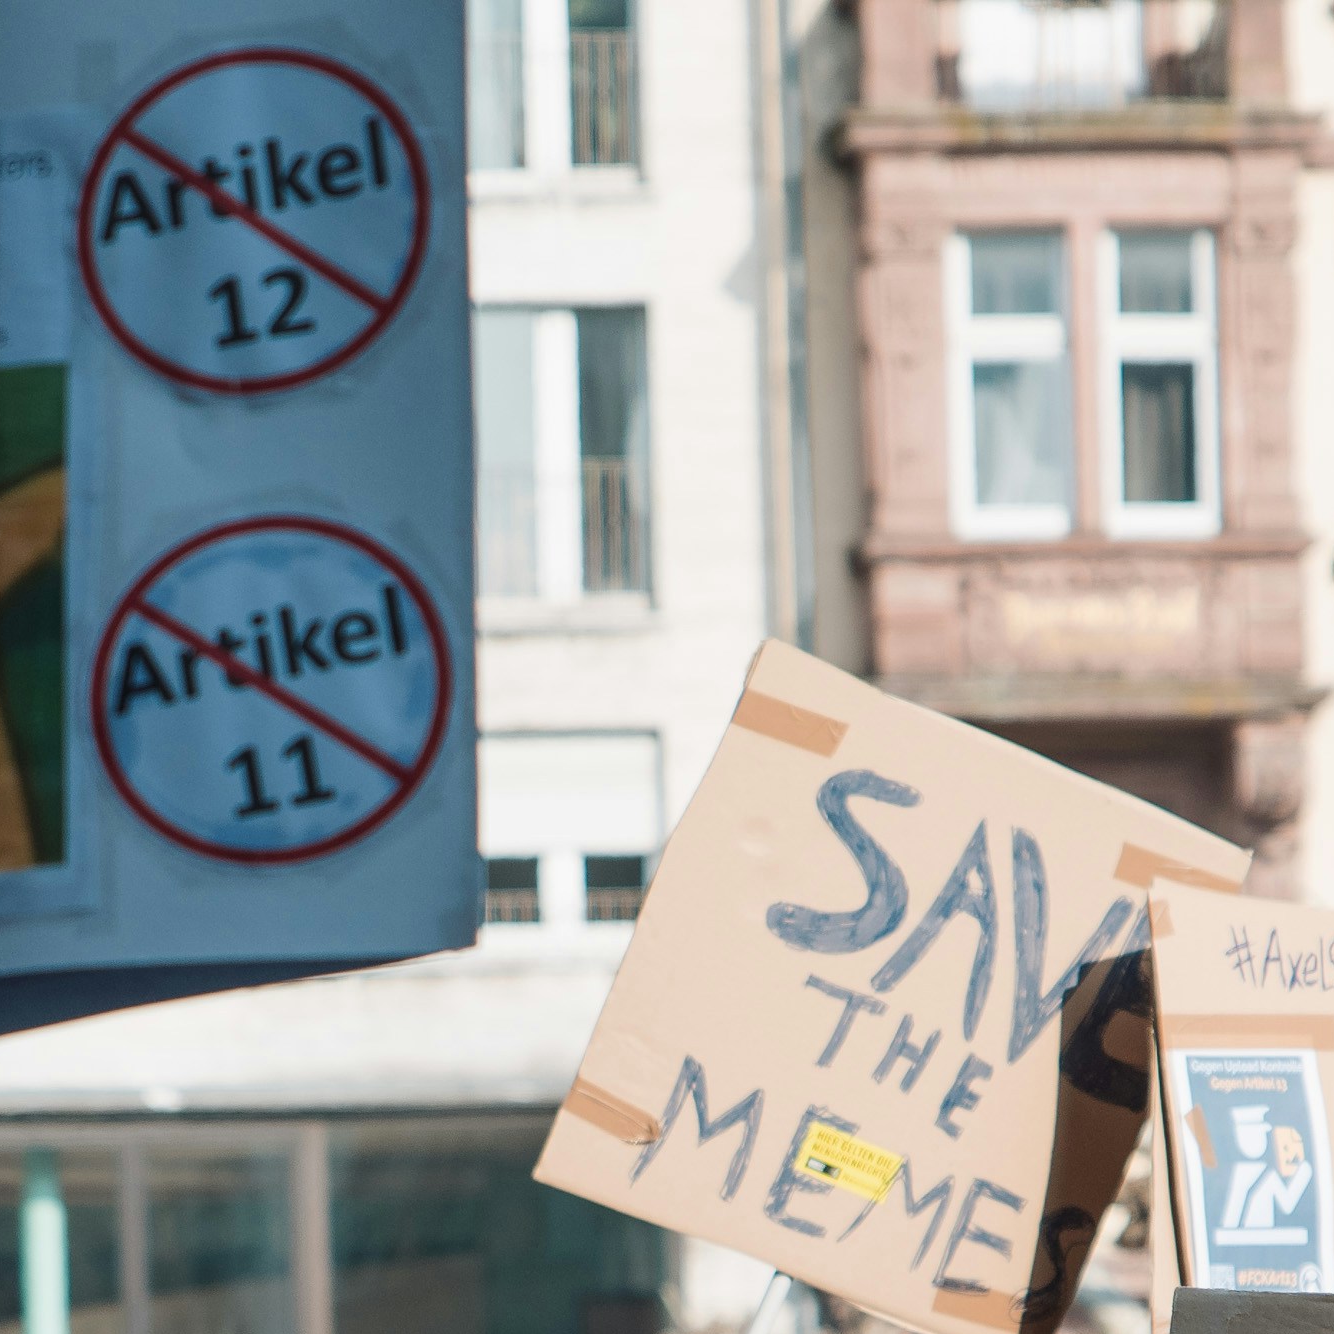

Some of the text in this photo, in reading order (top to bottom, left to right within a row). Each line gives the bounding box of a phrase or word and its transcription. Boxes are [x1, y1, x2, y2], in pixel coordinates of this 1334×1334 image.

[101, 116, 389, 244] Artikel
[208, 265, 319, 350] 12
[113, 582, 408, 719] Artikel
[225, 732, 339, 821] 11
[803, 973, 995, 1139] THE
